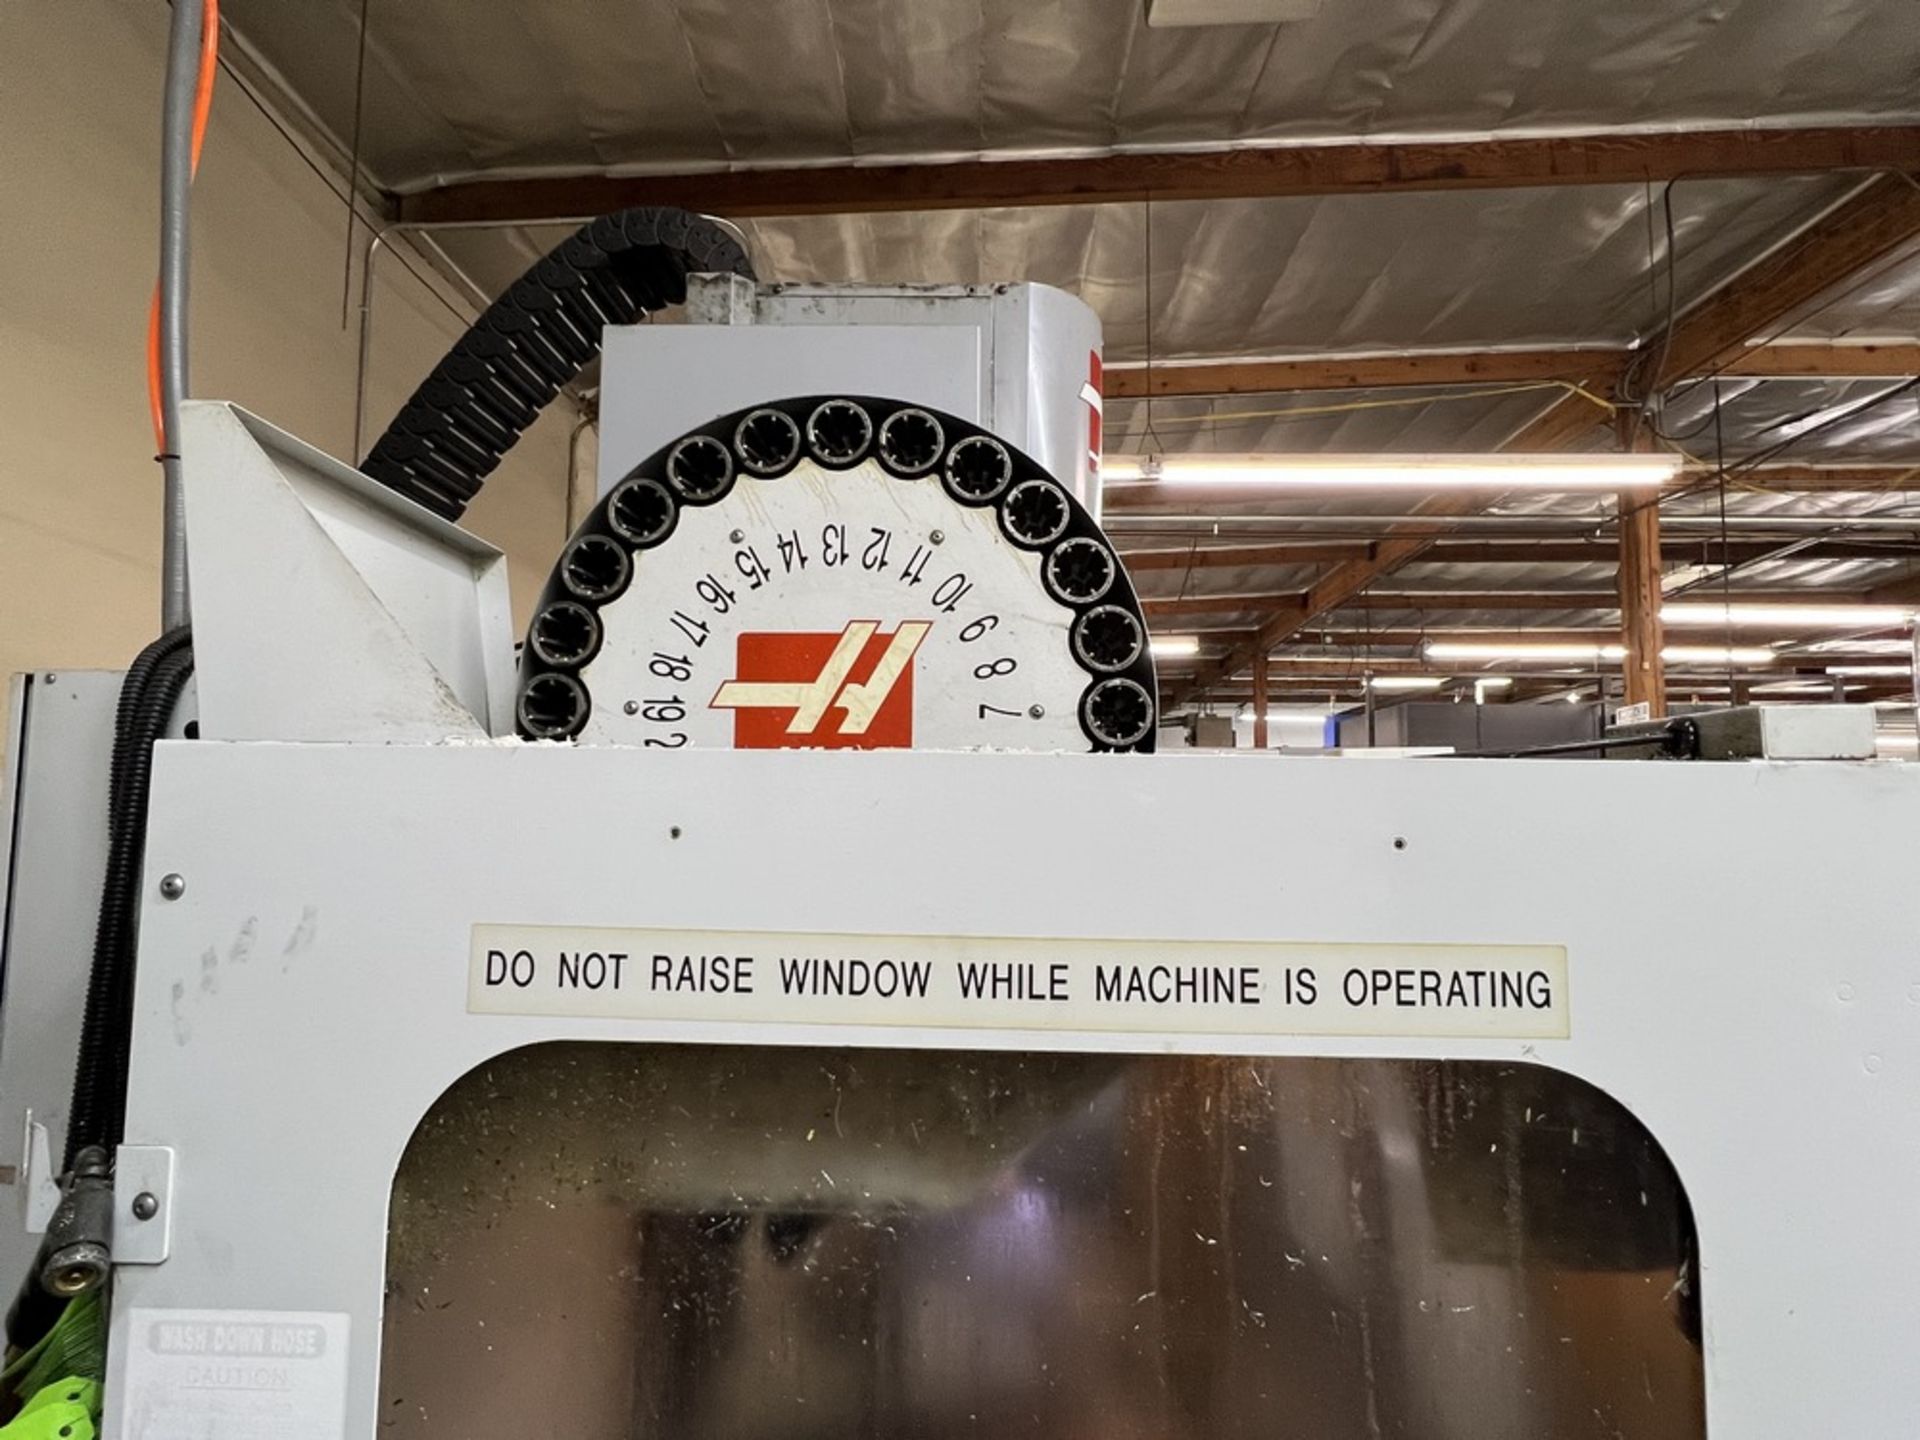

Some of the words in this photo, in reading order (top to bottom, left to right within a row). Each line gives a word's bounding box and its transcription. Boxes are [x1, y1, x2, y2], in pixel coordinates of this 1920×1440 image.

[777, 529, 808, 573] 14
[822, 524, 849, 567] 13
[861, 527, 892, 572] 12
[734, 546, 771, 590] 15
[899, 545, 932, 586] 11
[696, 573, 736, 614] 16
[931, 573, 973, 613] 10
[670, 610, 710, 648] 17
[959, 615, 999, 642] 9
[648, 652, 693, 682] 18
[973, 657, 1017, 680] 8
[642, 695, 686, 722] 19
[979, 704, 1022, 719] 7
[644, 732, 688, 748] 2
[486, 950, 535, 988] DO
[558, 952, 628, 990] NOT
[651, 955, 754, 993] RAISE
[779, 958, 932, 998] WINDOW
[957, 962, 1069, 1001] WHILE
[1096, 965, 1260, 1004] MACHINE
[1285, 968, 1317, 1005] IS
[1343, 968, 1551, 1009] OPERATING
[159, 1325, 208, 1350] WASH
[213, 1326, 264, 1352] DOWN
[270, 1327, 317, 1353] HOSE
[184, 1366, 289, 1386] CAUTION
